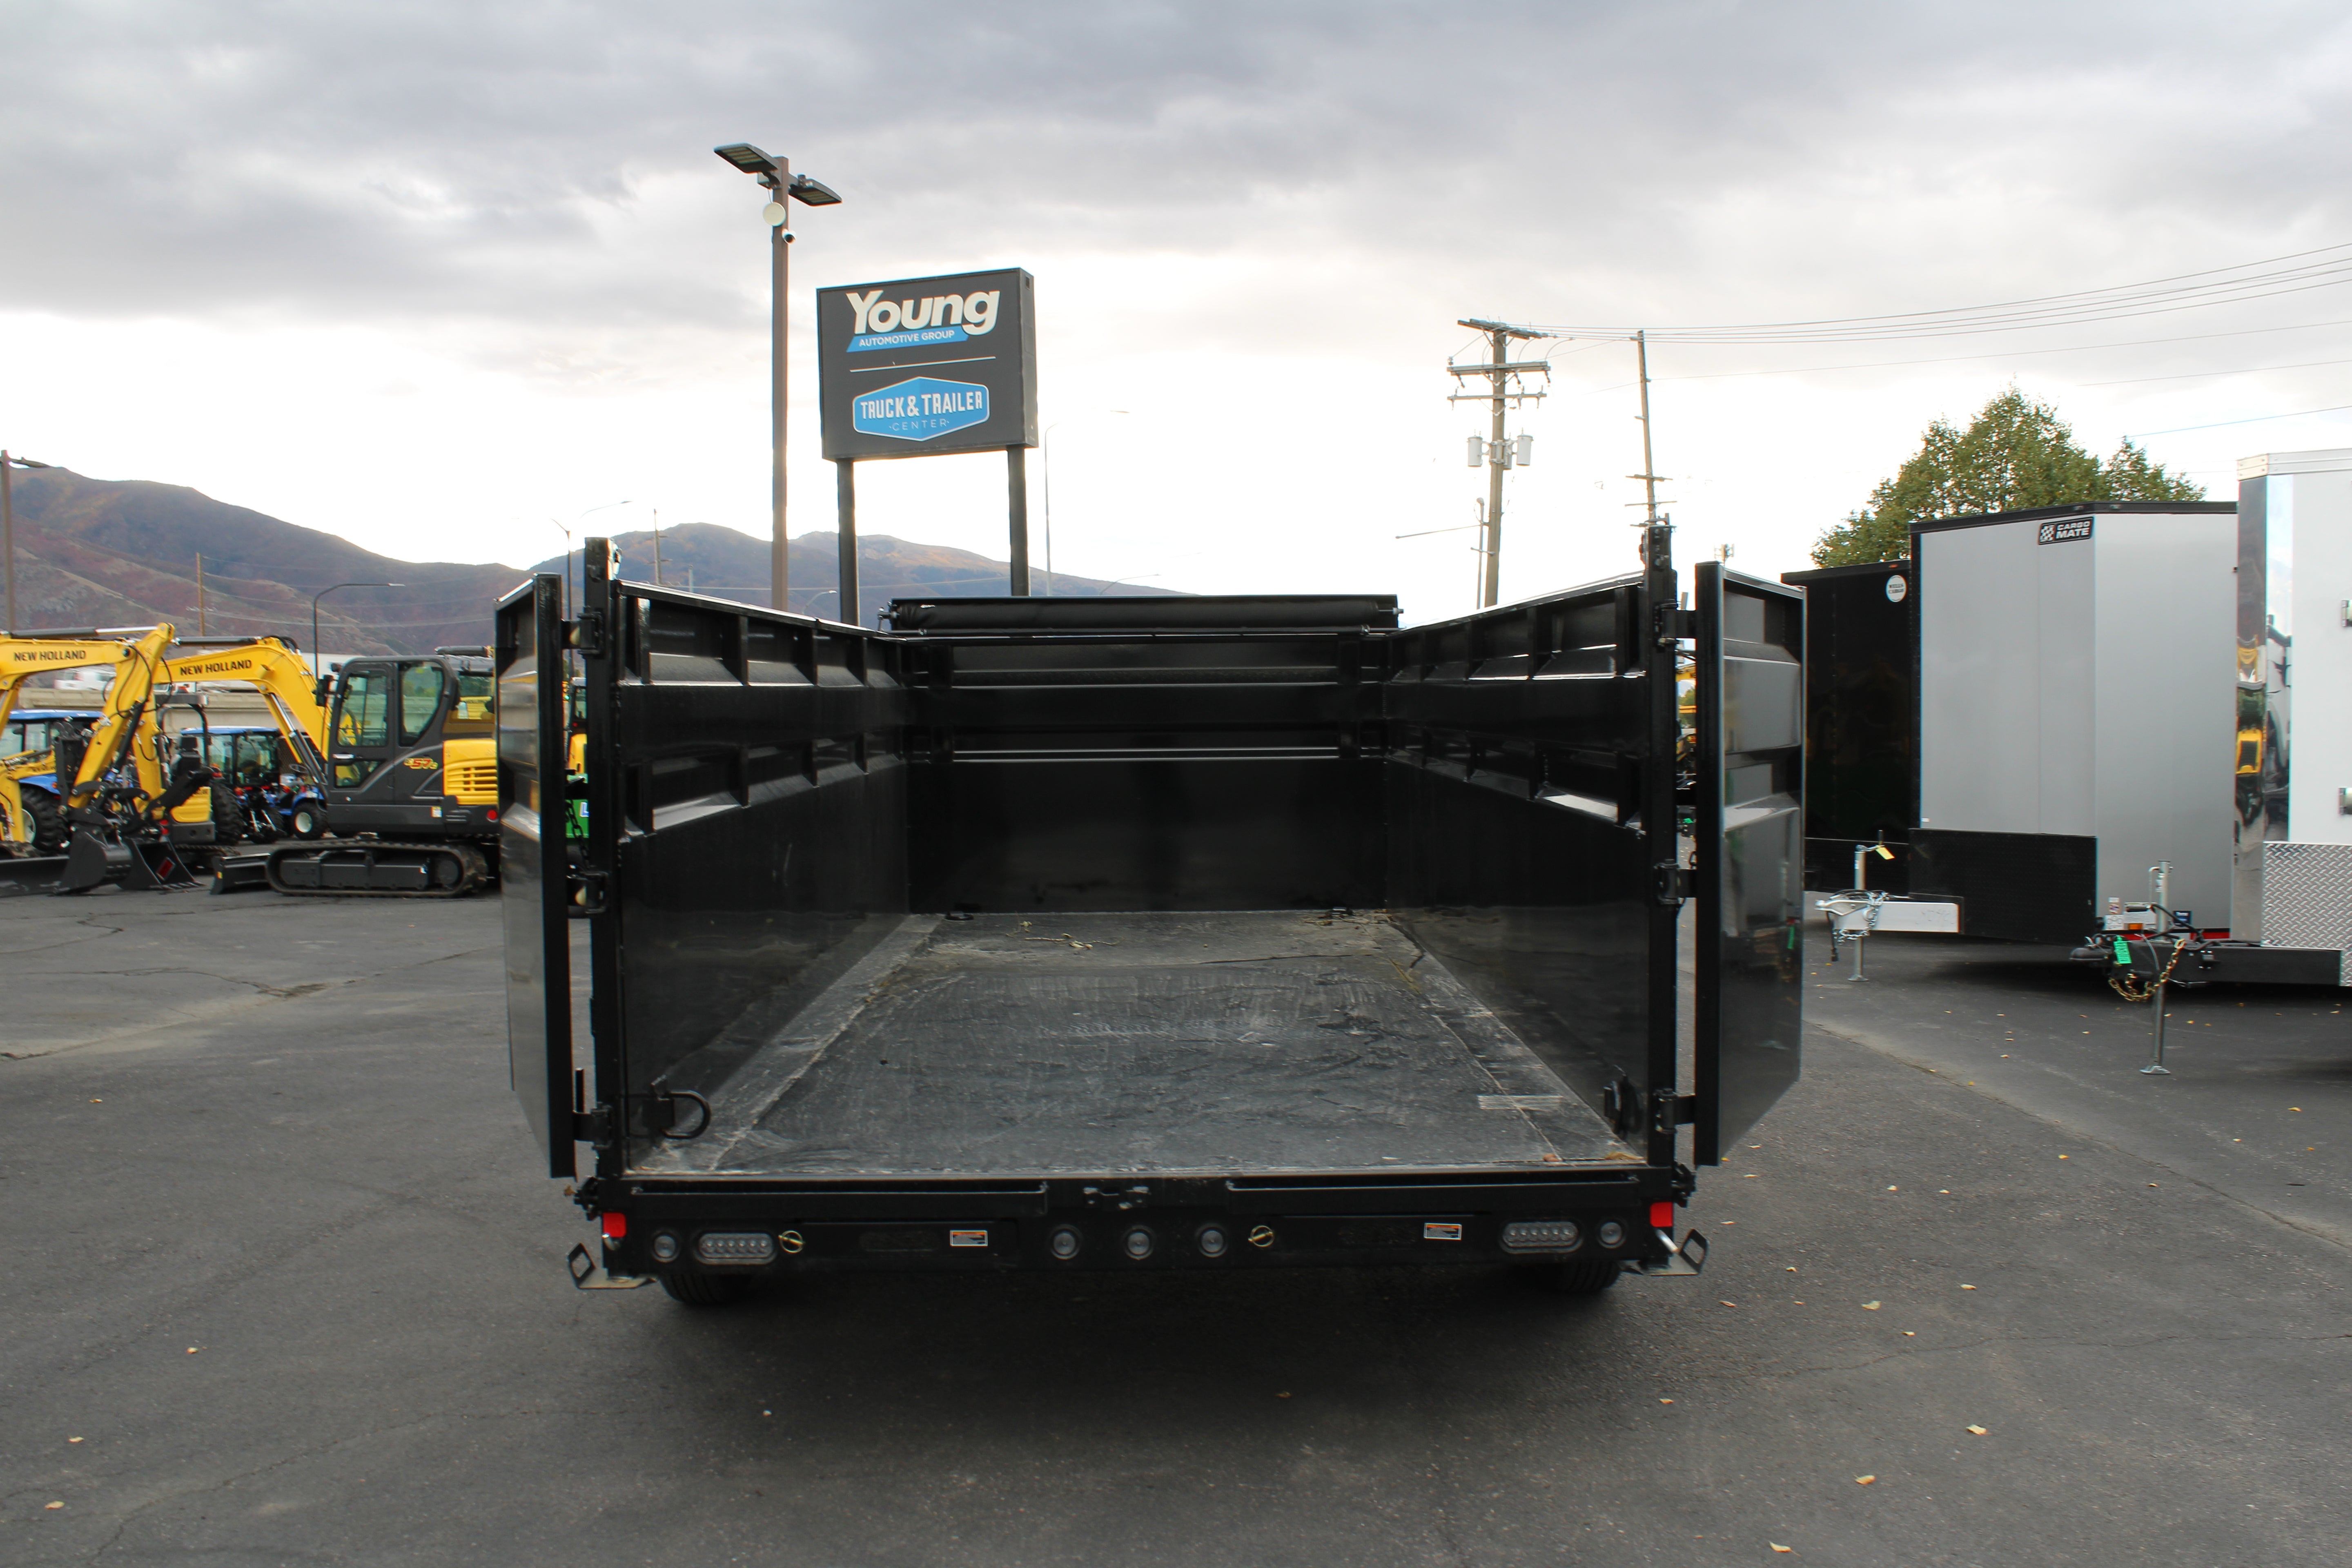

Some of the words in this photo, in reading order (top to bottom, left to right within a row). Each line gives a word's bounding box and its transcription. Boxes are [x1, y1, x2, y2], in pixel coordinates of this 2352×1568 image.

[846, 290, 1000, 335] Young
[859, 333, 919, 346] AUTOMOTIVE
[921, 330, 955, 340] GROUP
[860, 397, 905, 419] TRUCK
[907, 395, 920, 417] &
[921, 391, 982, 415] TRAILER
[892, 419, 947, 431] CENTER
[2057, 521, 2091, 530] CARGO
[2056, 527, 2089, 539] MATE
[14, 651, 37, 661] NEW
[39, 650, 87, 660] HOLLAND
[180, 665, 203, 676] NEW
[205, 659, 252, 673] HOLLAND
